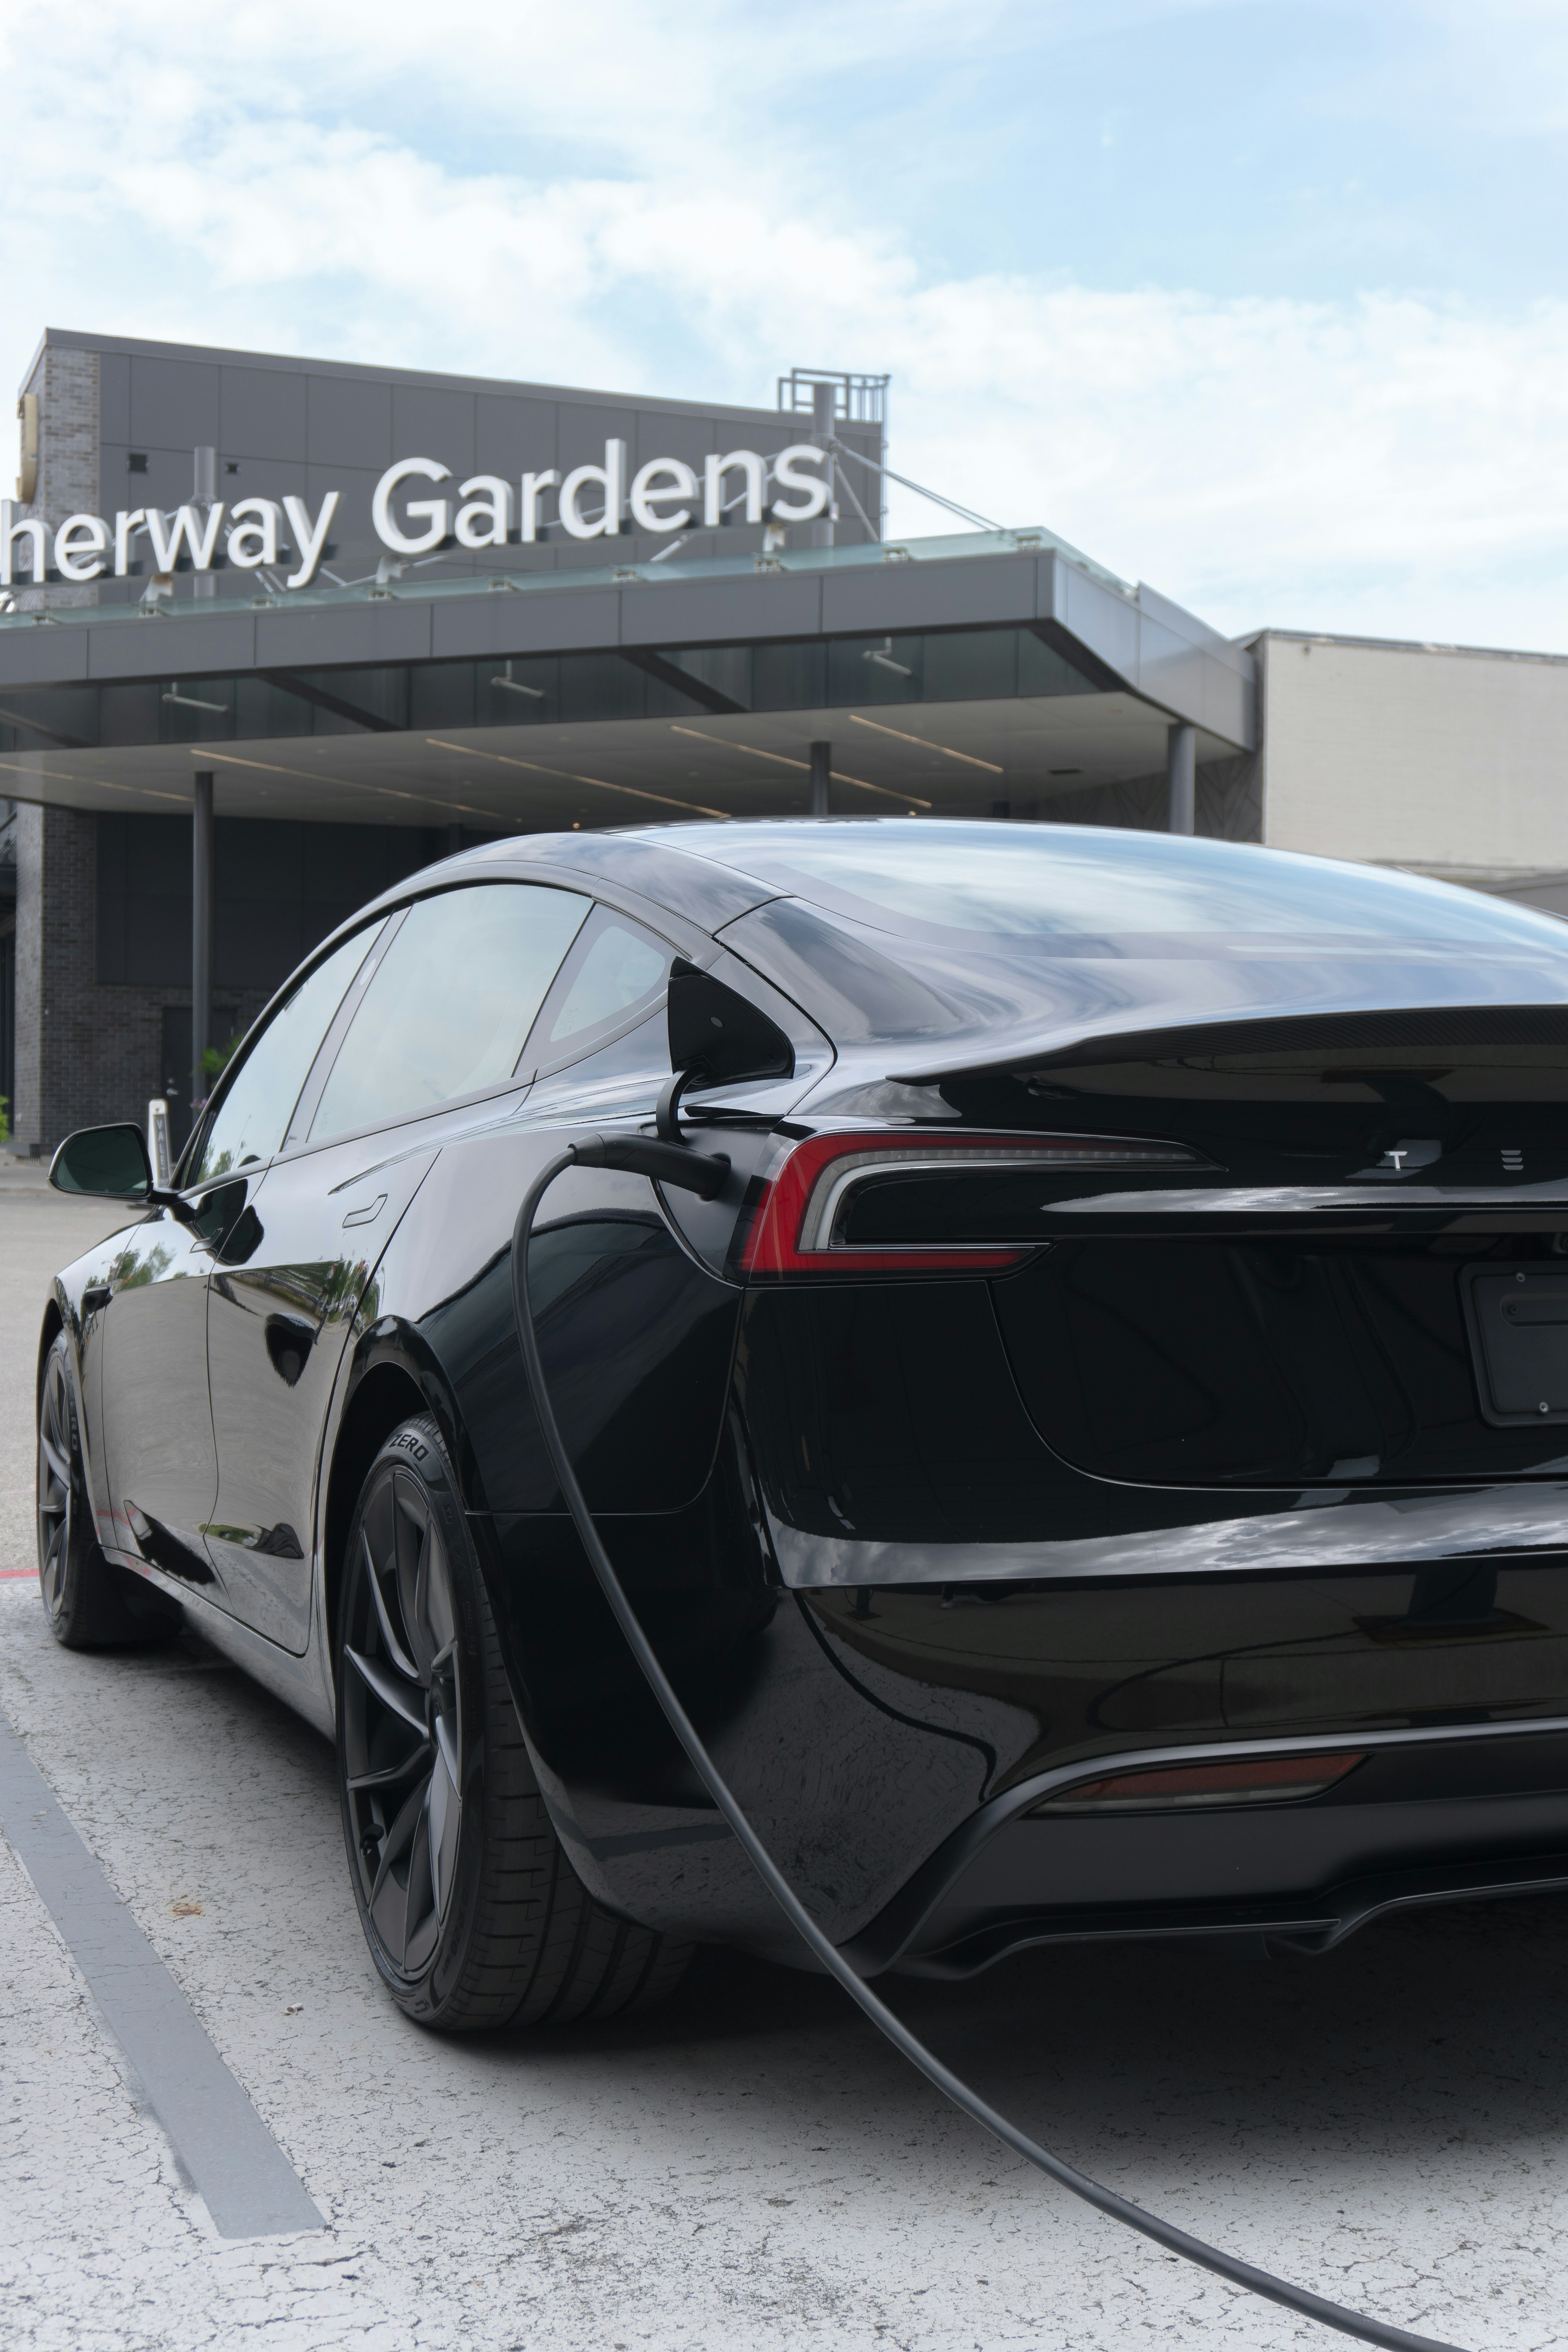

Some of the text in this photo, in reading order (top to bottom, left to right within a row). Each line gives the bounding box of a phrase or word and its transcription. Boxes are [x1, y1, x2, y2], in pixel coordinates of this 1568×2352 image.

[1, 438, 830, 588] herway Gardens
[157, 1118, 166, 1177] VALET
[388, 1433, 430, 1462] ZERO
